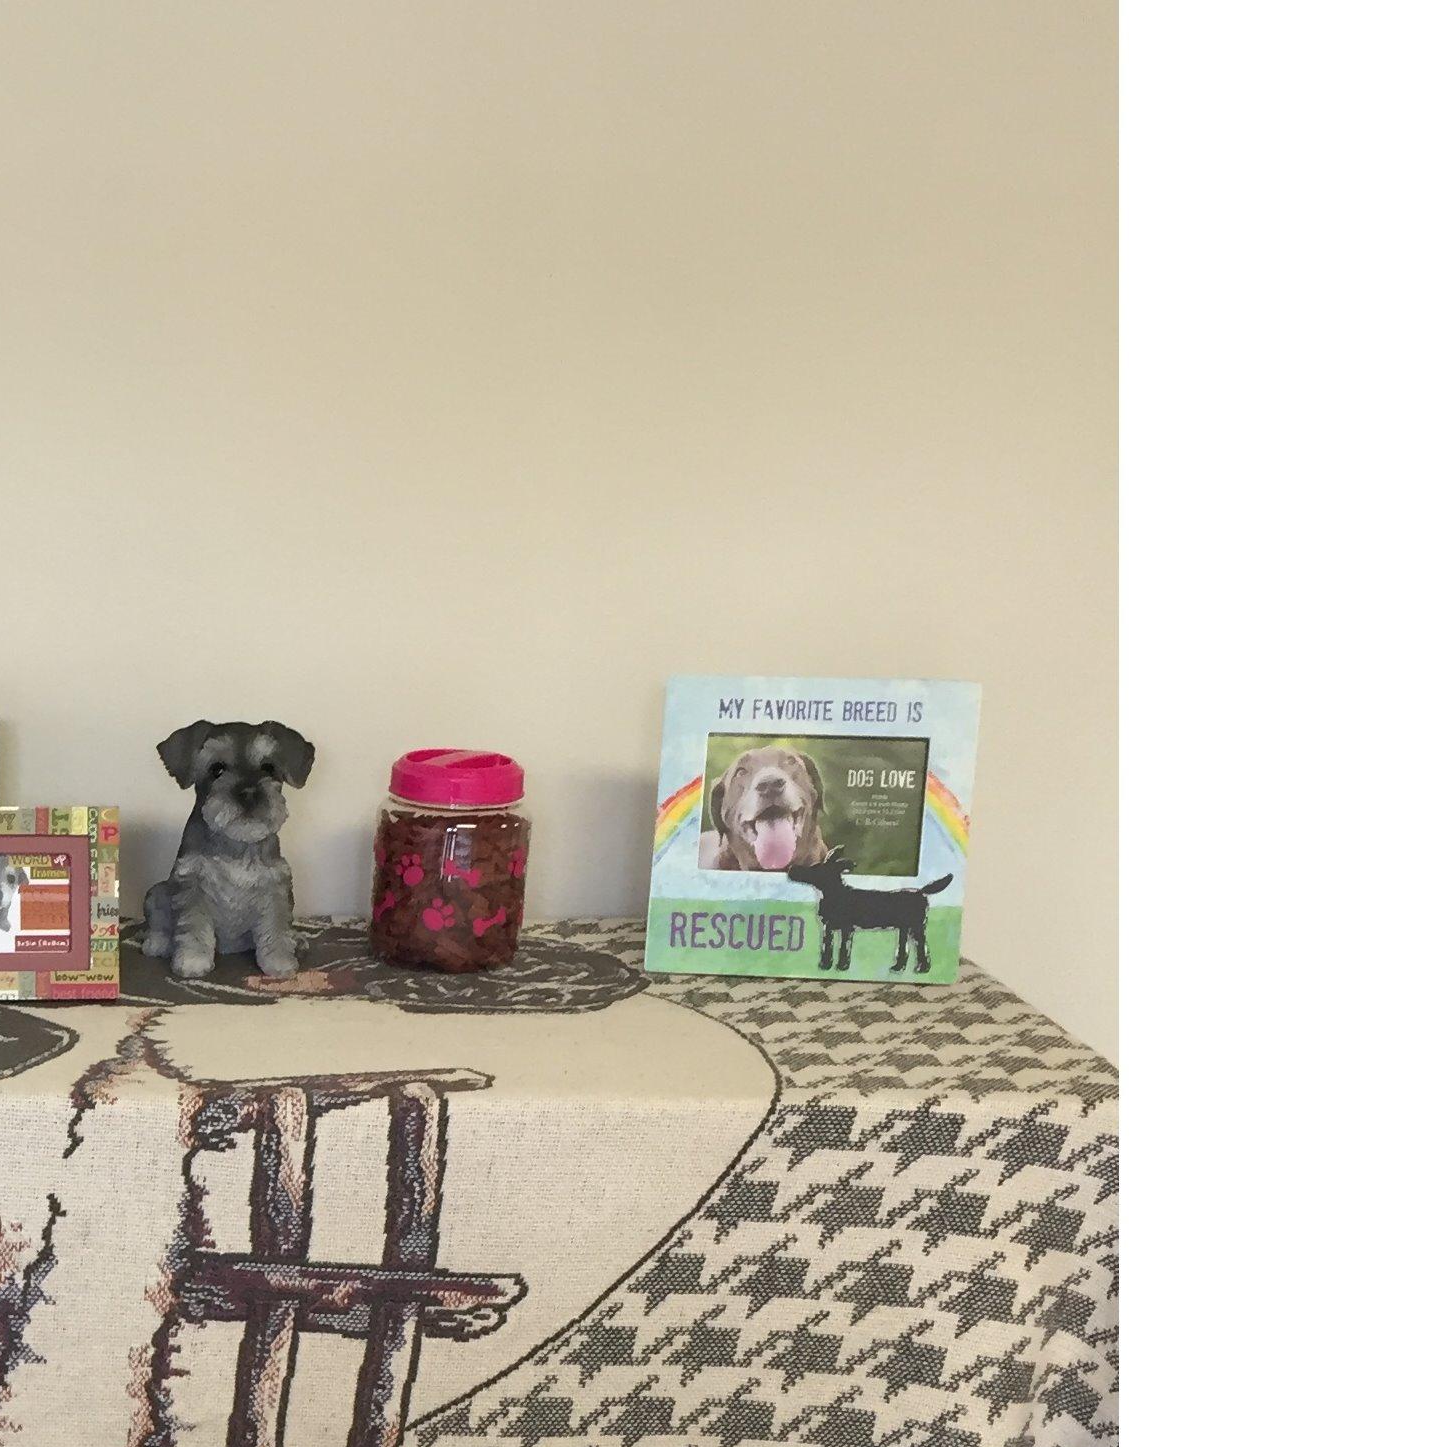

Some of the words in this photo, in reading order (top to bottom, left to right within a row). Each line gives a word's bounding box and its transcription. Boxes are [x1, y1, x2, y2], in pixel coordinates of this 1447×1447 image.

[719, 698, 745, 720] MY
[752, 698, 834, 722] FAVORITE
[842, 701, 897, 723] BREED
[907, 702, 923, 723] IS
[847, 769, 874, 788] DOG
[880, 770, 916, 789] LOVE
[13, 854, 50, 865] WORD
[669, 911, 805, 952] RESCUED
[55, 971, 114, 982] bow-wow
